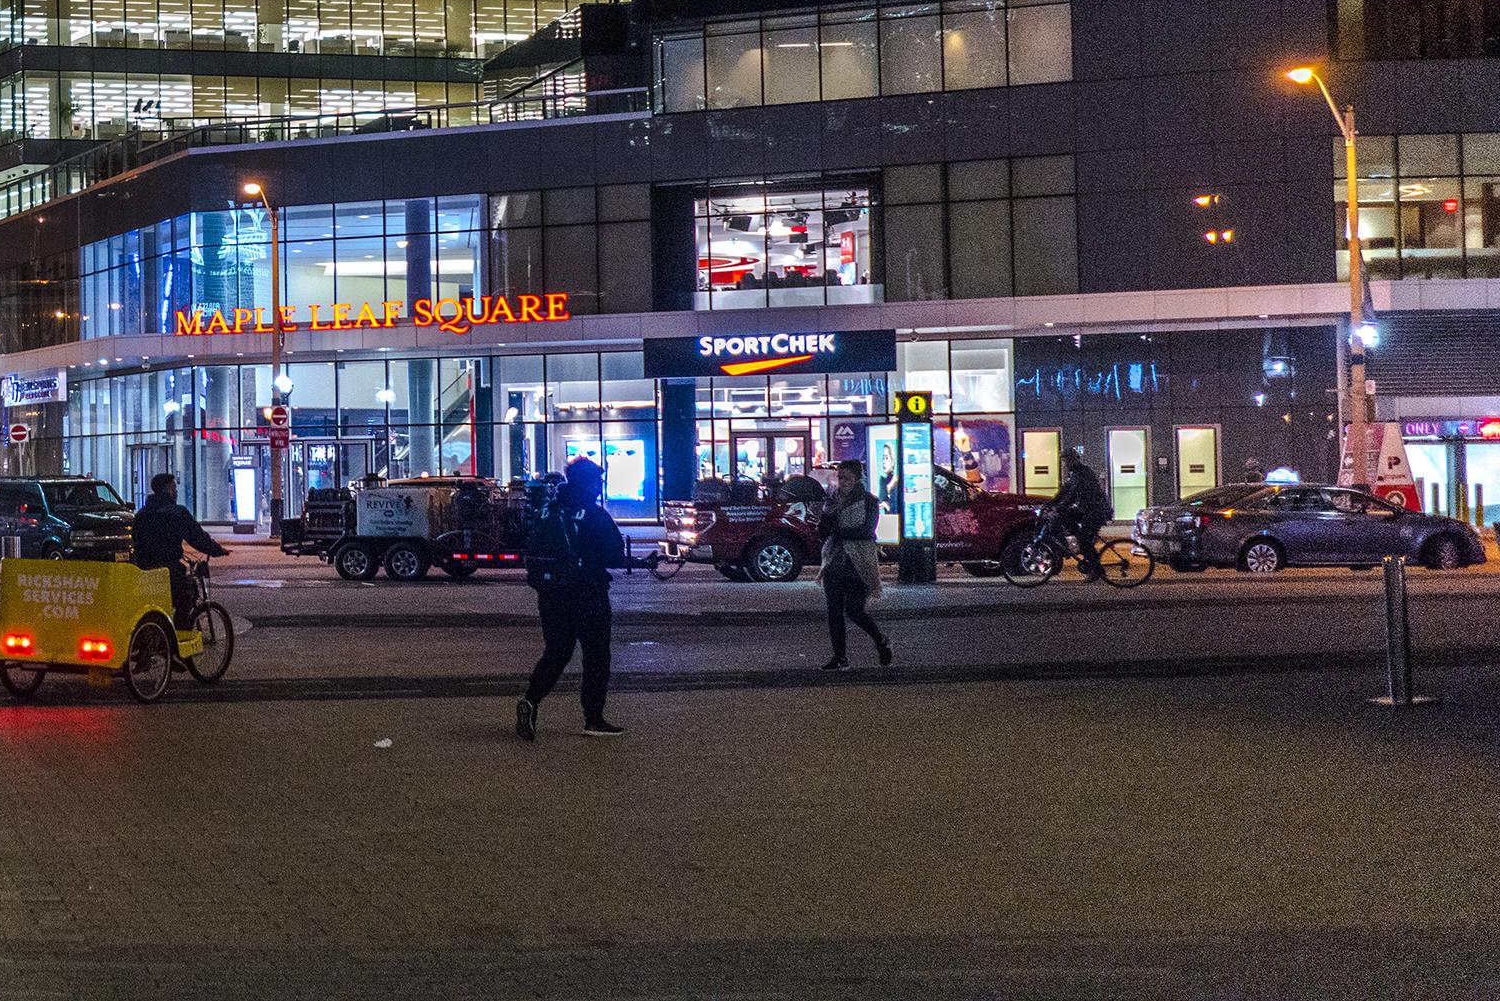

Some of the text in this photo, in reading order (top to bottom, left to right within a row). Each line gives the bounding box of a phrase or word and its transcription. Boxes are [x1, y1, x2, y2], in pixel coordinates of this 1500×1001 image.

[175, 305, 298, 336] MAPLE
[308, 300, 404, 331] LEAF
[413, 292, 570, 334] SQUARE
[699, 333, 836, 356] SPORTCHEK
[1405, 422, 1443, 435] ONLY
[366, 500, 401, 510] REVIVE
[17, 573, 99, 589] RICKSHAW
[23, 588, 94, 605] SERVICES
